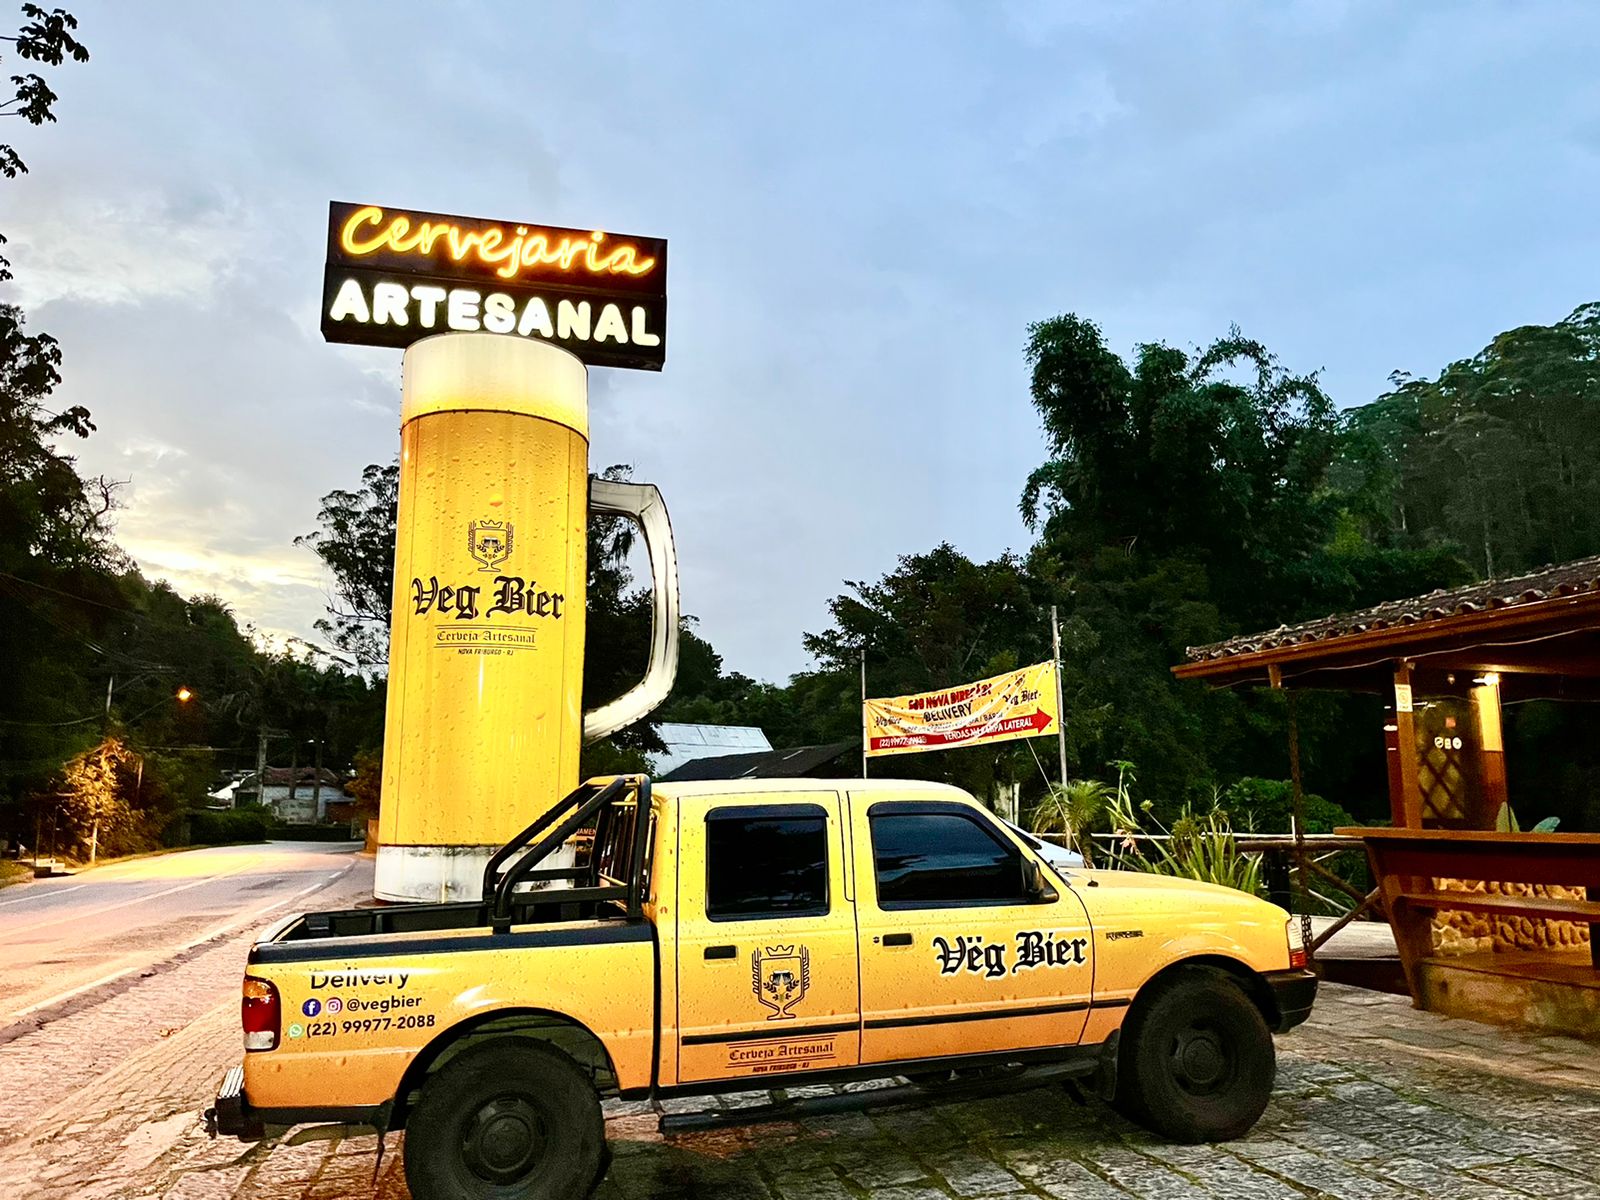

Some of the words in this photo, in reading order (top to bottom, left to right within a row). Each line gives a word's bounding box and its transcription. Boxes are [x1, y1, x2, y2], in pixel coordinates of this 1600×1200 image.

[341, 204, 656, 279] Cervejaria
[329, 278, 661, 347] ARTESANAL
[411, 575, 481, 620] Veg
[485, 575, 565, 620] Bier
[436, 630, 479, 642] Cerveja
[483, 630, 536, 644] Artesanal
[923, 702, 972, 723] DELIVERY
[943, 727, 971, 741] VENDAS
[1004, 717, 1033, 731] LATERAL
[1011, 931, 1088, 974] Bier
[310, 967, 409, 990] Delivery
[346, 995, 422, 1013] @vegbier
[306, 1022, 338, 1039] (22)
[342, 1014, 436, 1034] 99977-2088
[729, 1049, 774, 1061] Cerveja
[777, 1042, 834, 1057] Artesanal
